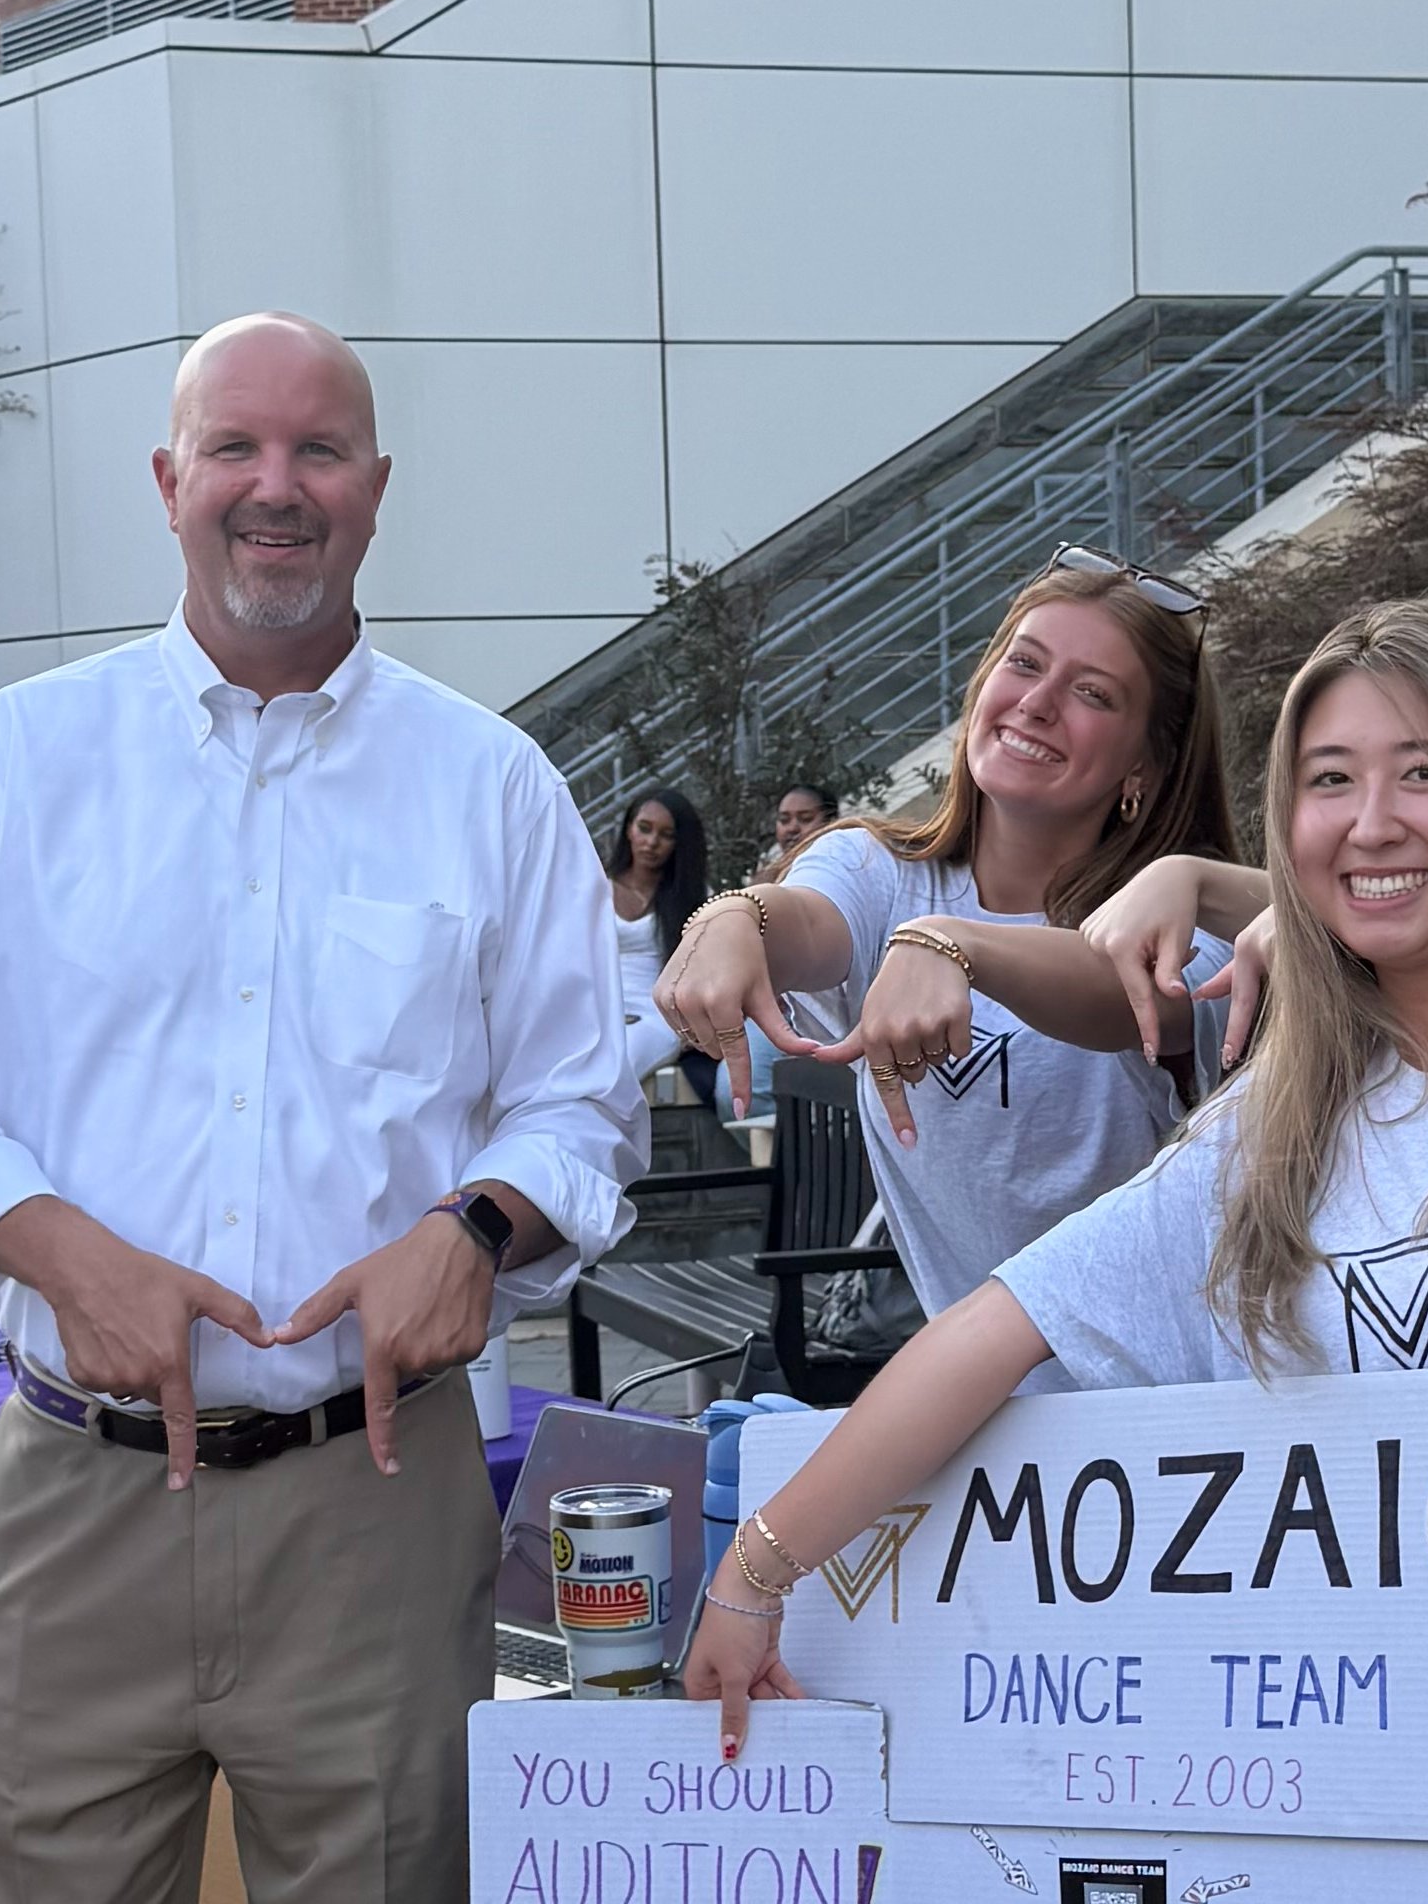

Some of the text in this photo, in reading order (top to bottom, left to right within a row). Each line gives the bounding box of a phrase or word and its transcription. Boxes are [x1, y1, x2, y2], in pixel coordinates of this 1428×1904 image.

[963, 1652, 1388, 1731] DANCE TEAM
[513, 1752, 833, 1815] YOU SHOULD
[1066, 1752, 1304, 1814] EST. 2003
[1062, 1862, 1099, 1874] MOZAIC
[1136, 1865, 1164, 1876] TEAM
